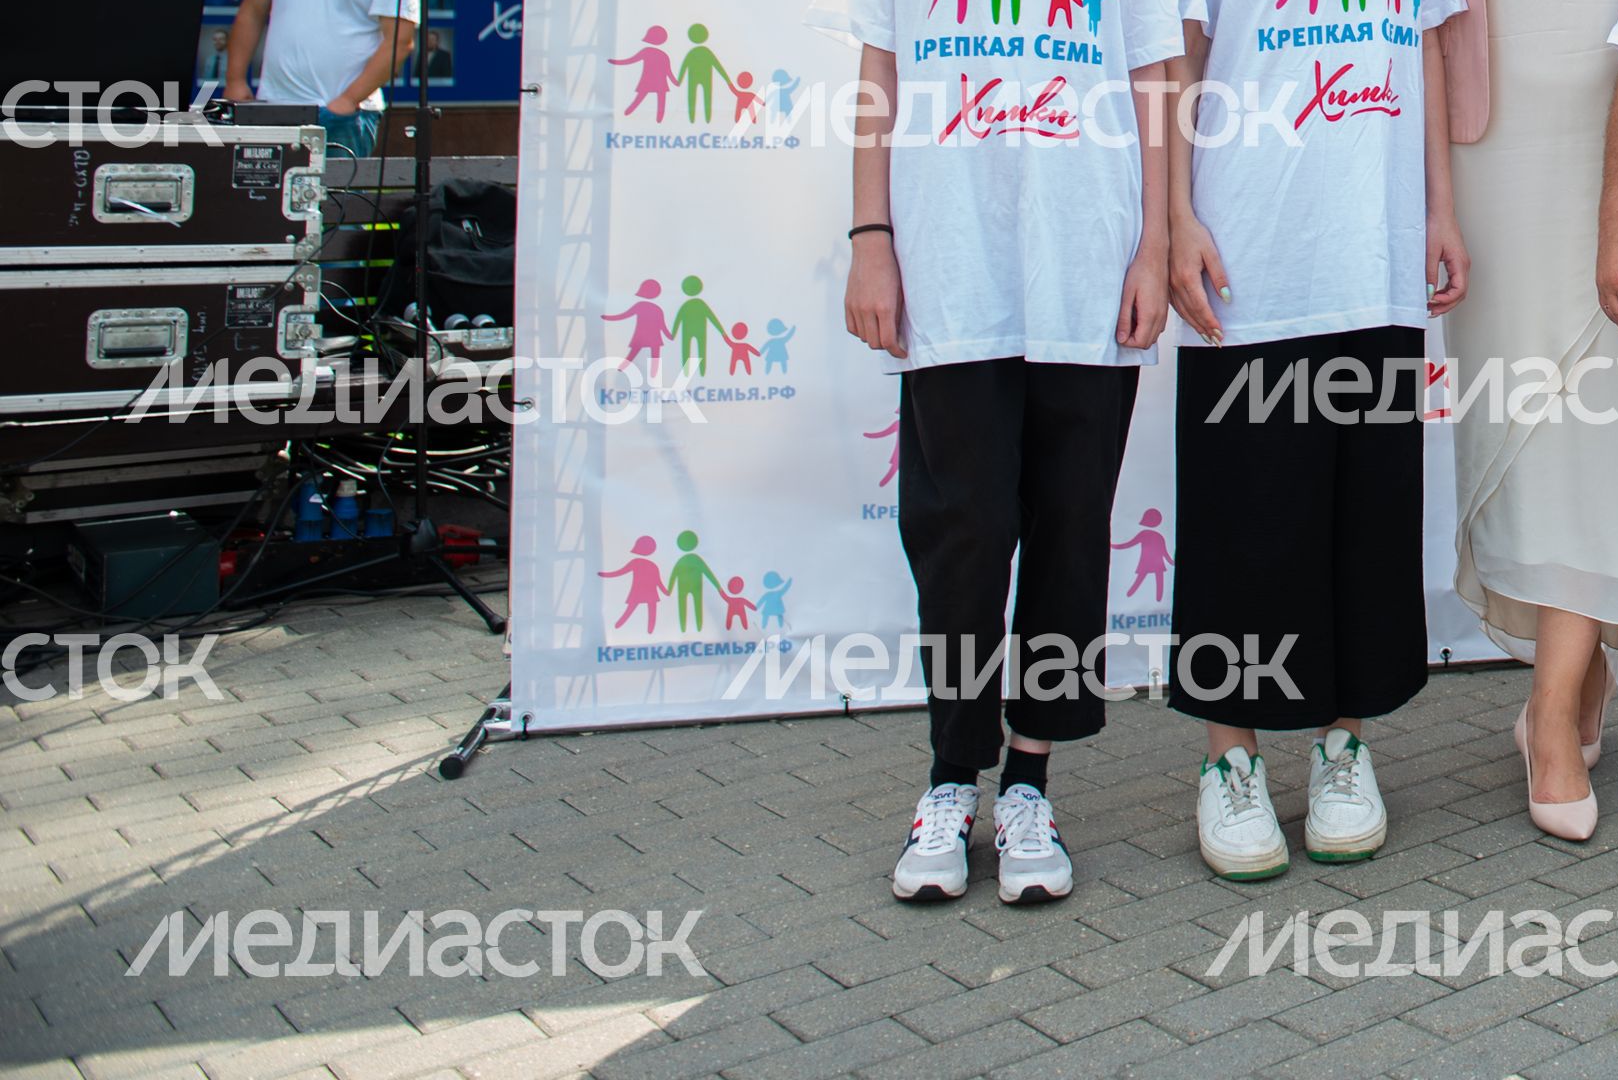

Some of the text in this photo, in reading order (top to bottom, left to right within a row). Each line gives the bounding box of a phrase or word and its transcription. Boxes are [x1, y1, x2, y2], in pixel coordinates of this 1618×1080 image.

[1034, 33, 1103, 65] СЕМЬ
[1258, 21, 1373, 52] КРЕПКАЯ
[938, 72, 1080, 146] Химки
